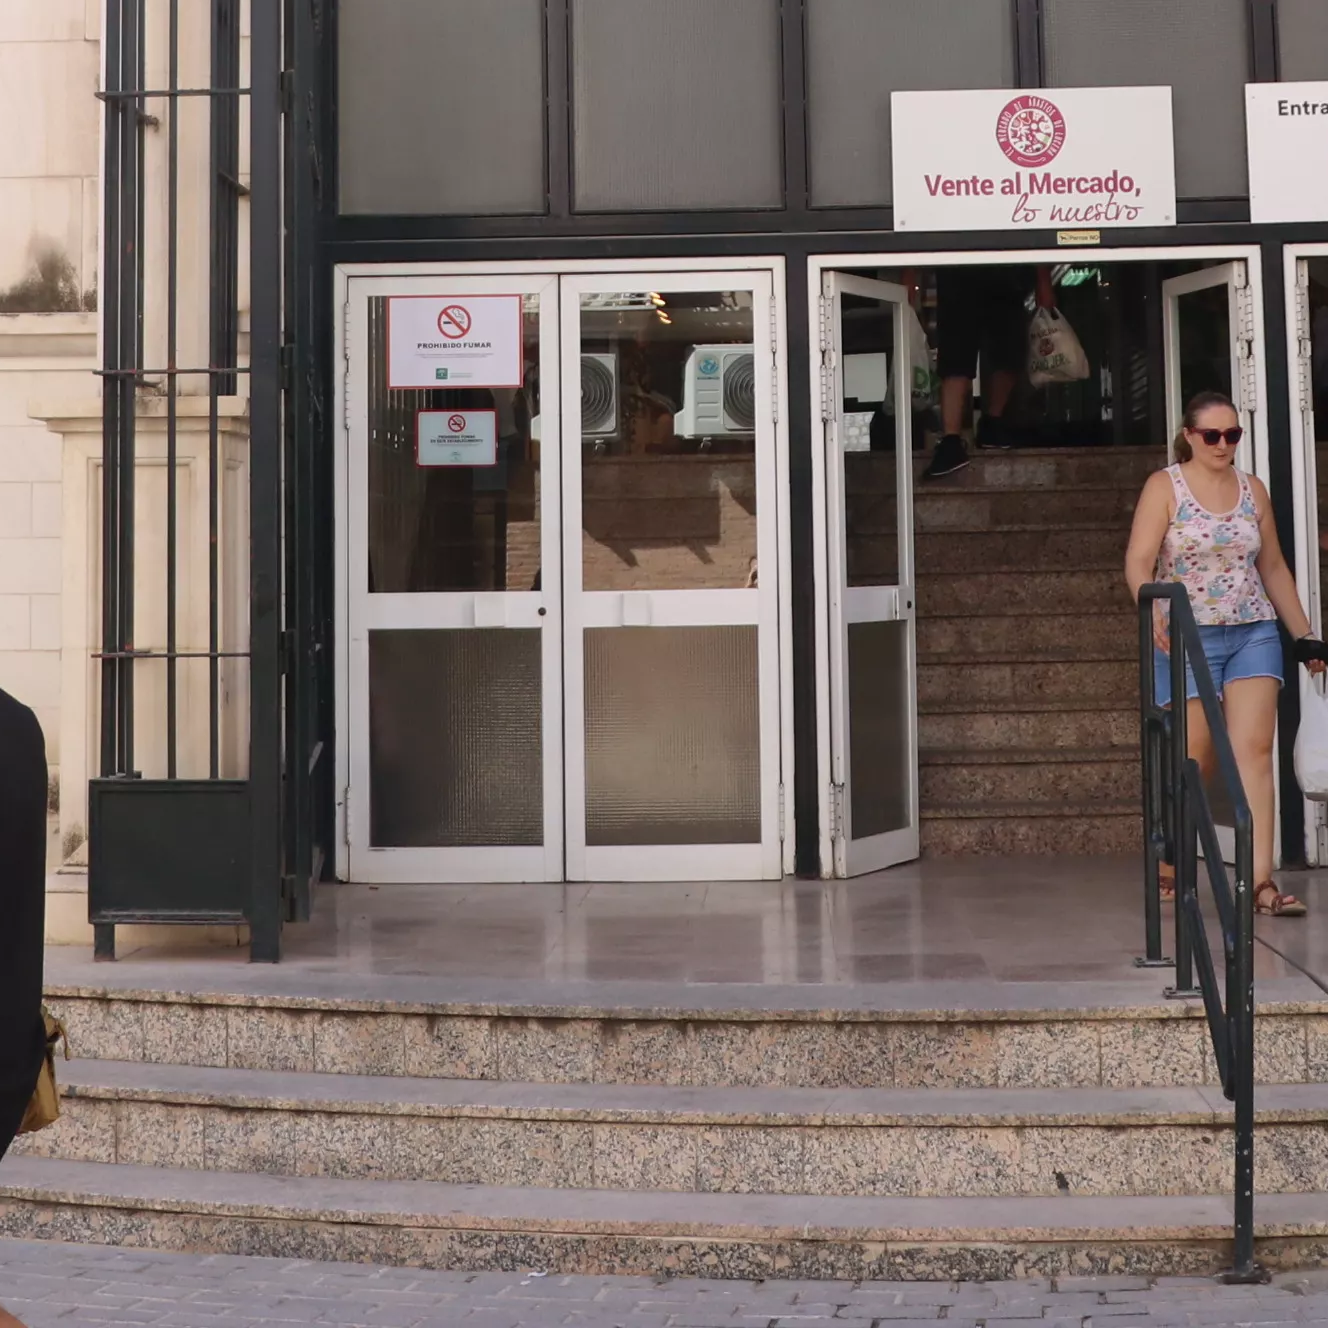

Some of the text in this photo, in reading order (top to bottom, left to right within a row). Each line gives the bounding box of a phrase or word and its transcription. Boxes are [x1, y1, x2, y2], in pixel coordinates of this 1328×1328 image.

[924, 169, 1141, 197] Vente al Mercado,
[1012, 192, 1145, 223] lo nuestro
